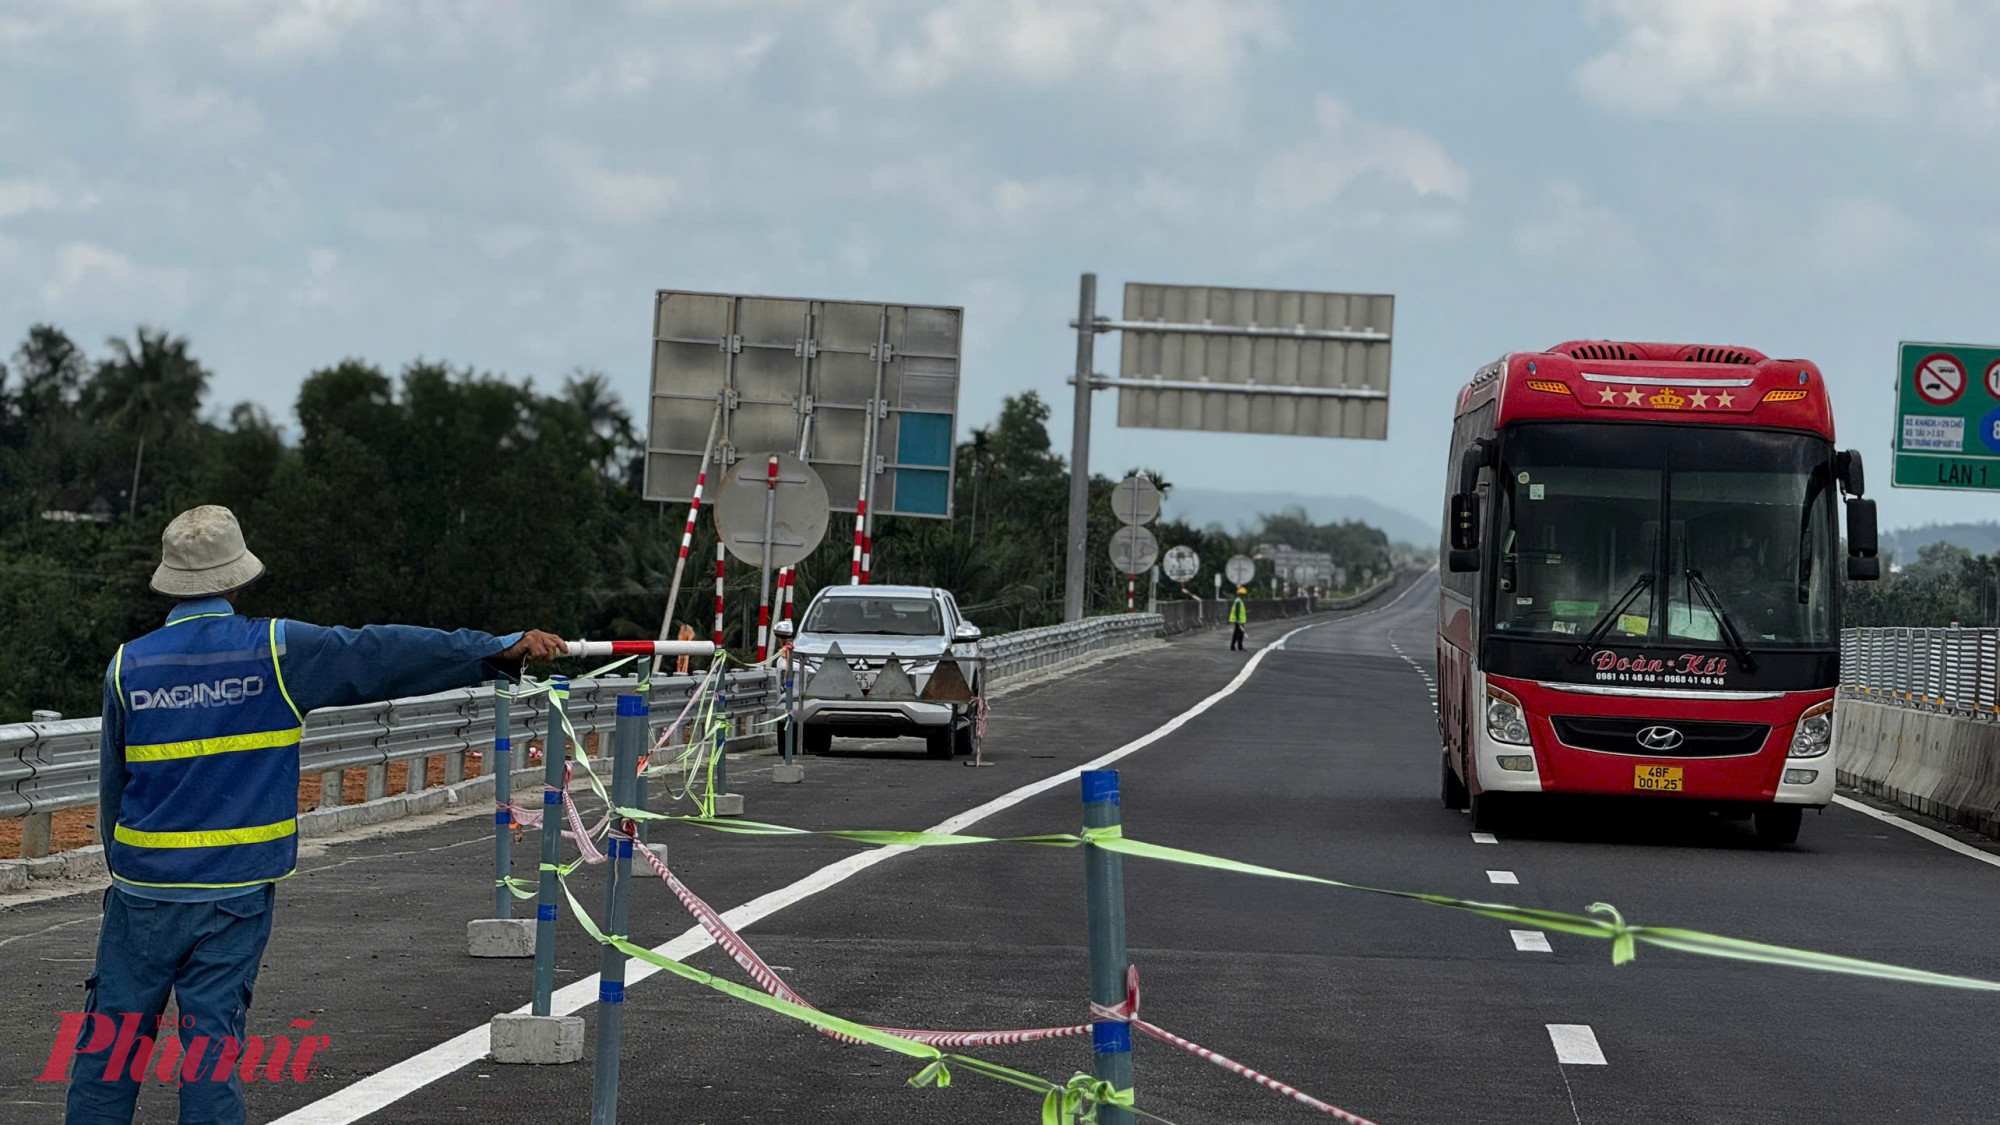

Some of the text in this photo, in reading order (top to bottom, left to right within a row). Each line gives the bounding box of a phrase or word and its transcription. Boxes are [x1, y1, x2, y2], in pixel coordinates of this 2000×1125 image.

[1938, 459, 1986, 486] LÀN 1
[1591, 650, 1727, 676] Đoàn Kết
[1648, 768, 1670, 778] 48F
[1640, 778, 1678, 790] 001.25
